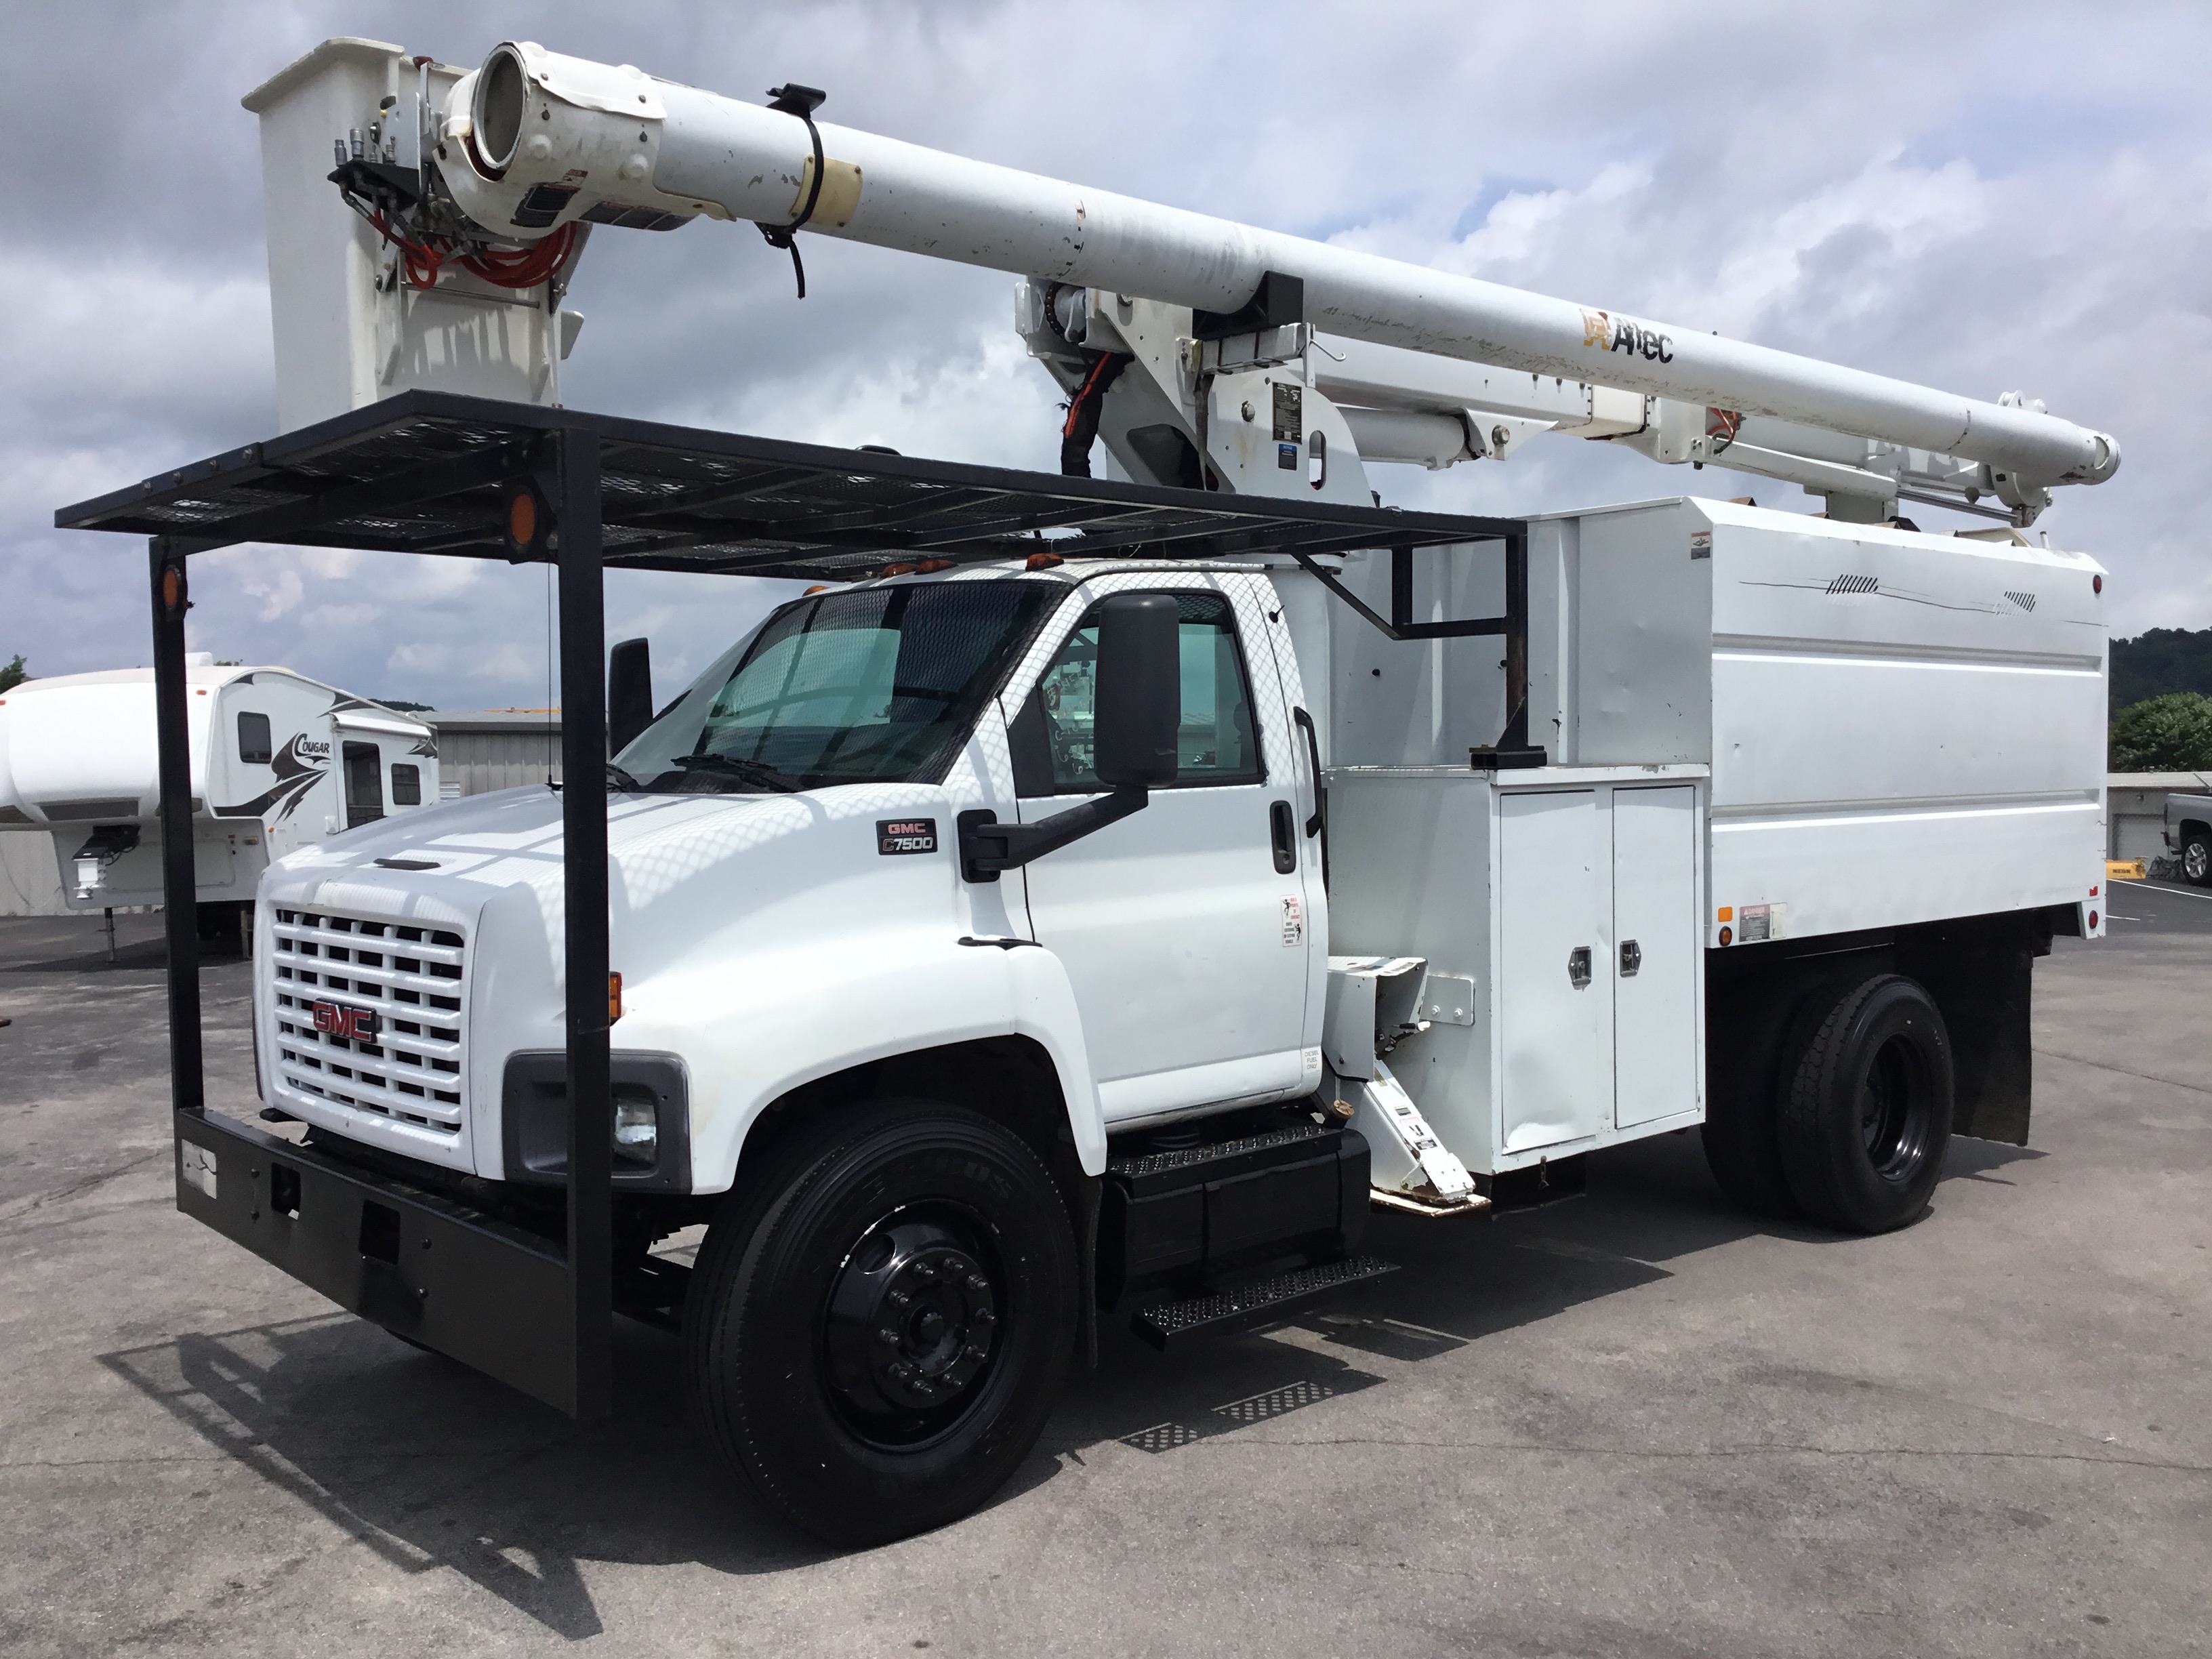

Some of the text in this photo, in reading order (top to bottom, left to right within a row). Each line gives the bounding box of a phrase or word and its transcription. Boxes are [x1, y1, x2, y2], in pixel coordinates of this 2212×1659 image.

[888, 823, 926, 835] GMC
[882, 837, 934, 852] C7500
[312, 1001, 372, 1042] GMC
